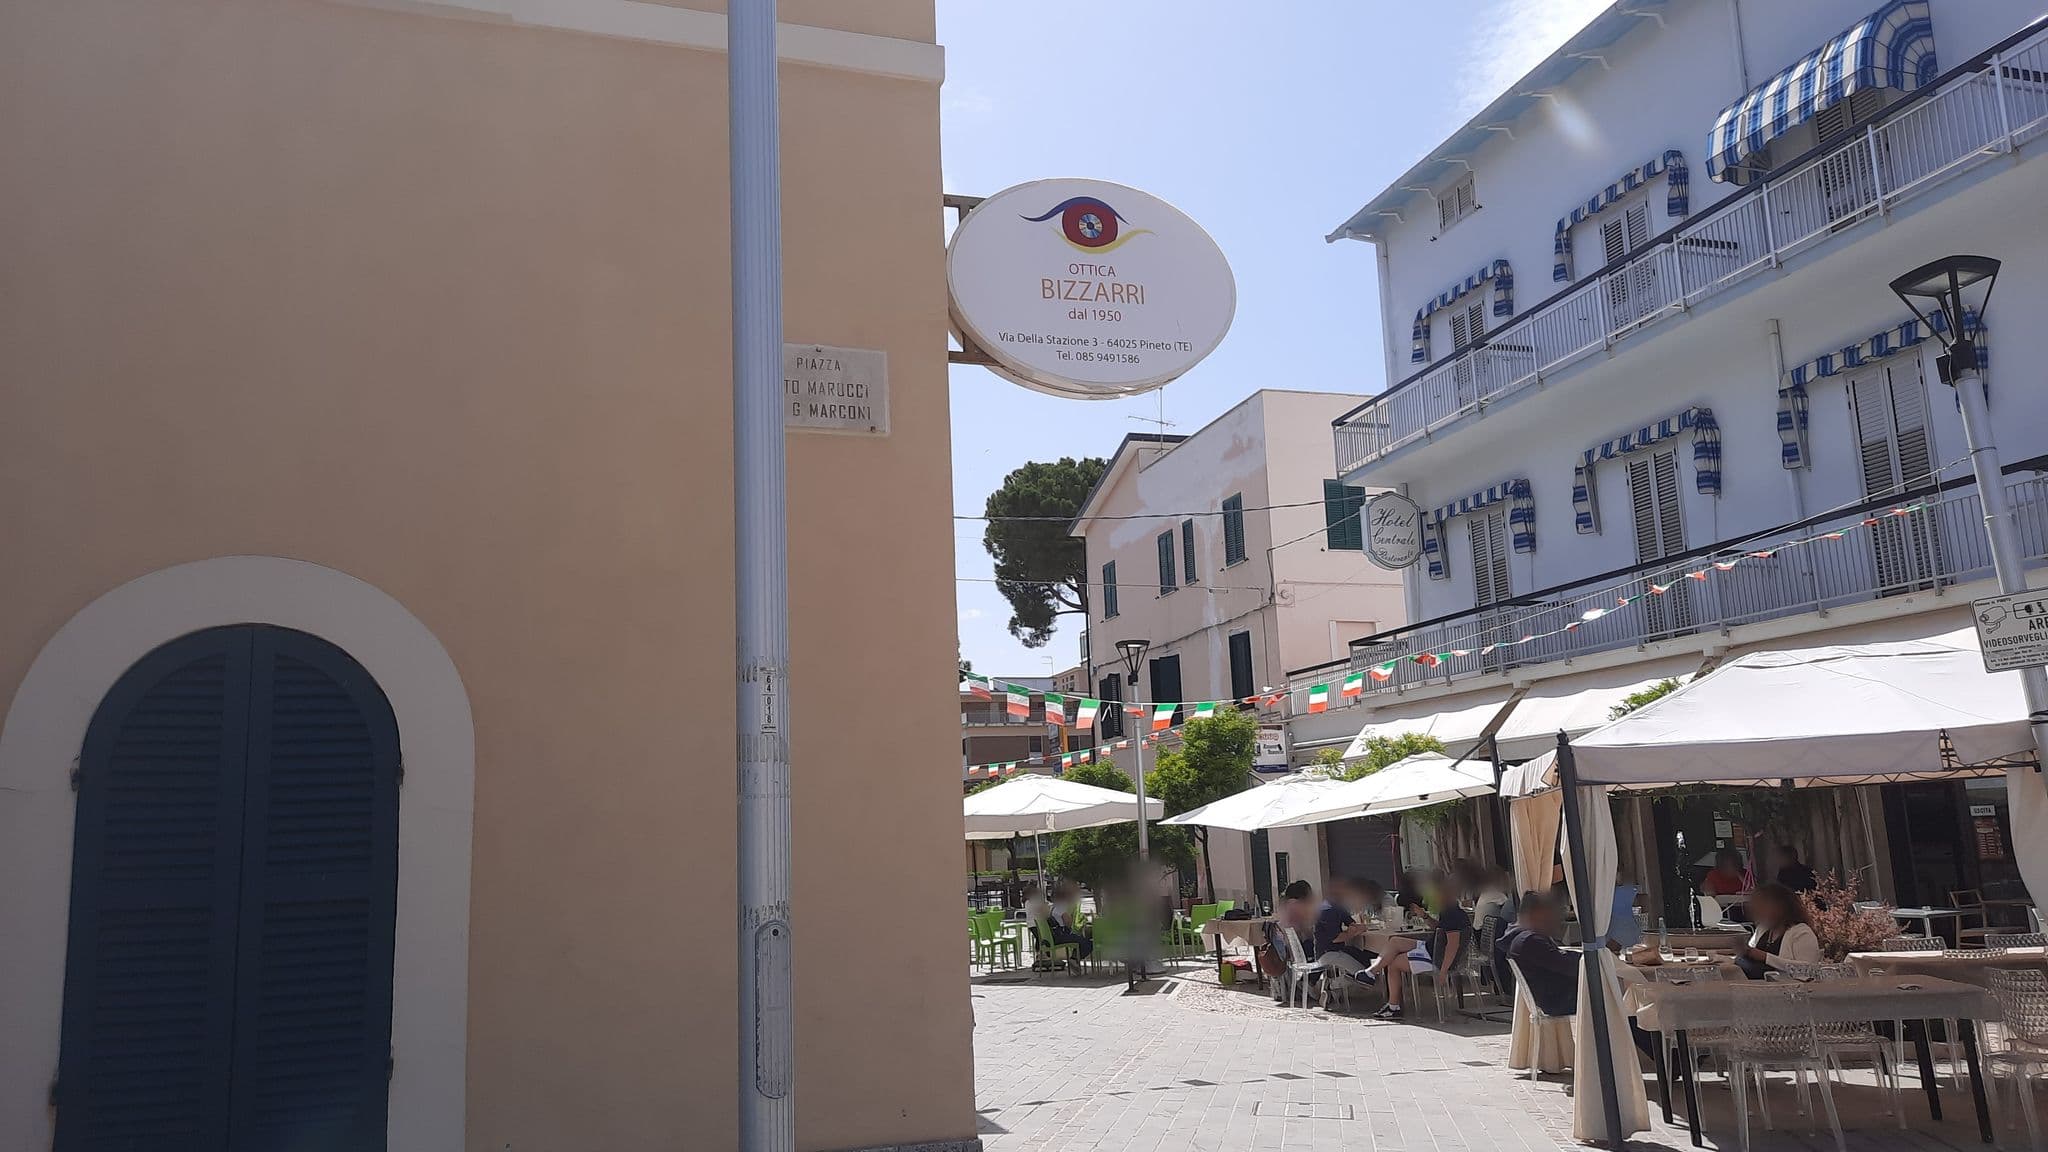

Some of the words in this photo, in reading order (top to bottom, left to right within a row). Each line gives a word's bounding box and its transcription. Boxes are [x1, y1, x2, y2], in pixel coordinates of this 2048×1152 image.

[1069, 263, 1116, 277] OTTICA
[1041, 278, 1145, 305] BIZZARRI
[1068, 307, 1088, 320] dal
[1092, 309, 1122, 322] 1950
[998, 332, 1015, 343] Via
[1017, 333, 1044, 344] Della
[1046, 335, 1090, 347] Stazione
[1092, 338, 1098, 347] 3
[1106, 338, 1137, 349] 64025
[1140, 340, 1171, 351] Pineto
[1174, 341, 1193, 352] (TE)
[796, 357, 841, 372] PIAZZA
[1056, 350, 1073, 361] Tel.
[1076, 352, 1095, 362] 085
[1097, 352, 1140, 364] 9491586
[807, 381, 869, 399] MARUCCI
[809, 403, 871, 420] MARCONI
[1371, 508, 1416, 528] Hotel
[1373, 527, 1416, 546] Centrale
